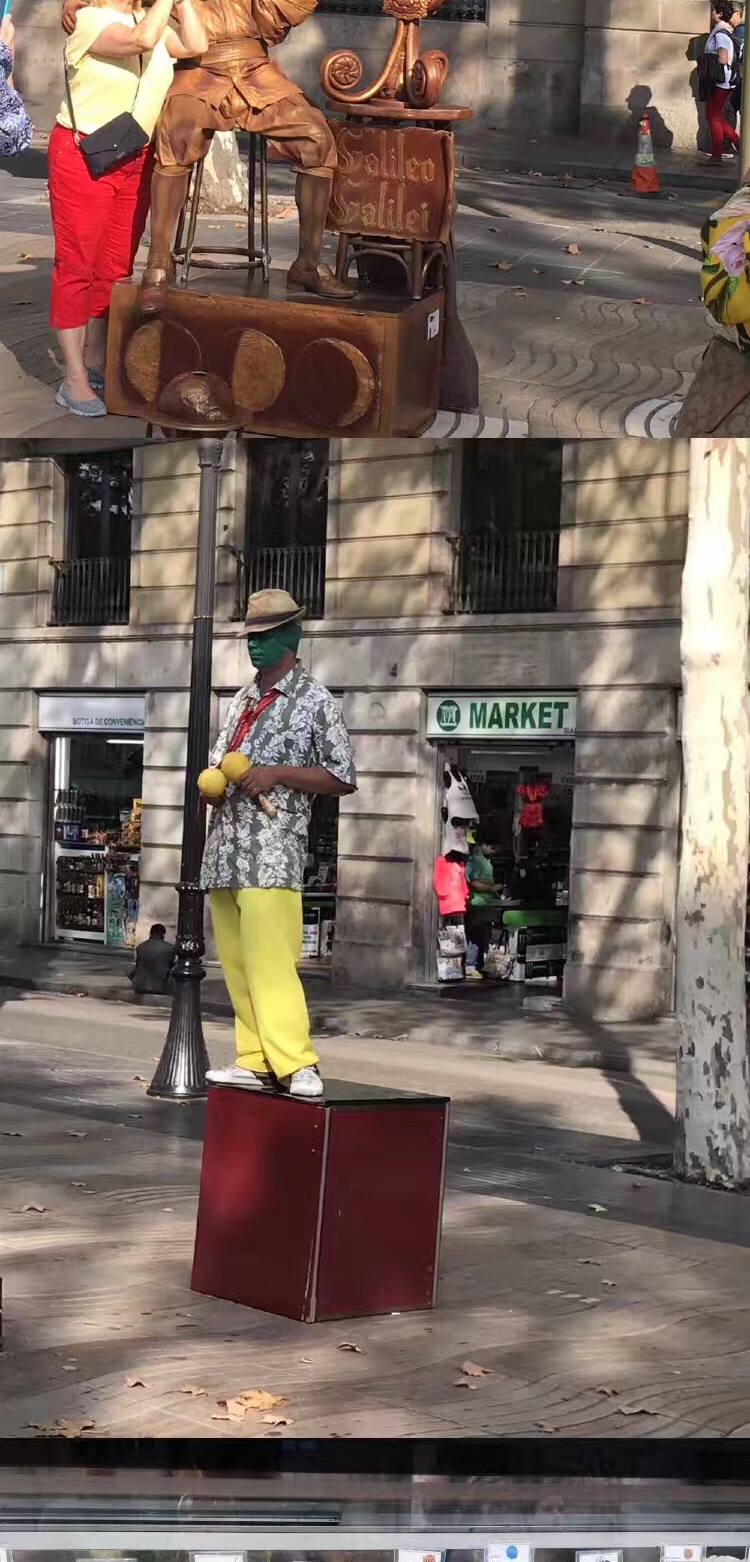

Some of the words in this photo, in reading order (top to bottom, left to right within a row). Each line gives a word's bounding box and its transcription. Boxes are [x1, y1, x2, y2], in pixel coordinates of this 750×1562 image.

[72, 718, 94, 726] BOTIGA
[95, 718, 103, 726] DE
[469, 701, 569, 730] MARKET
